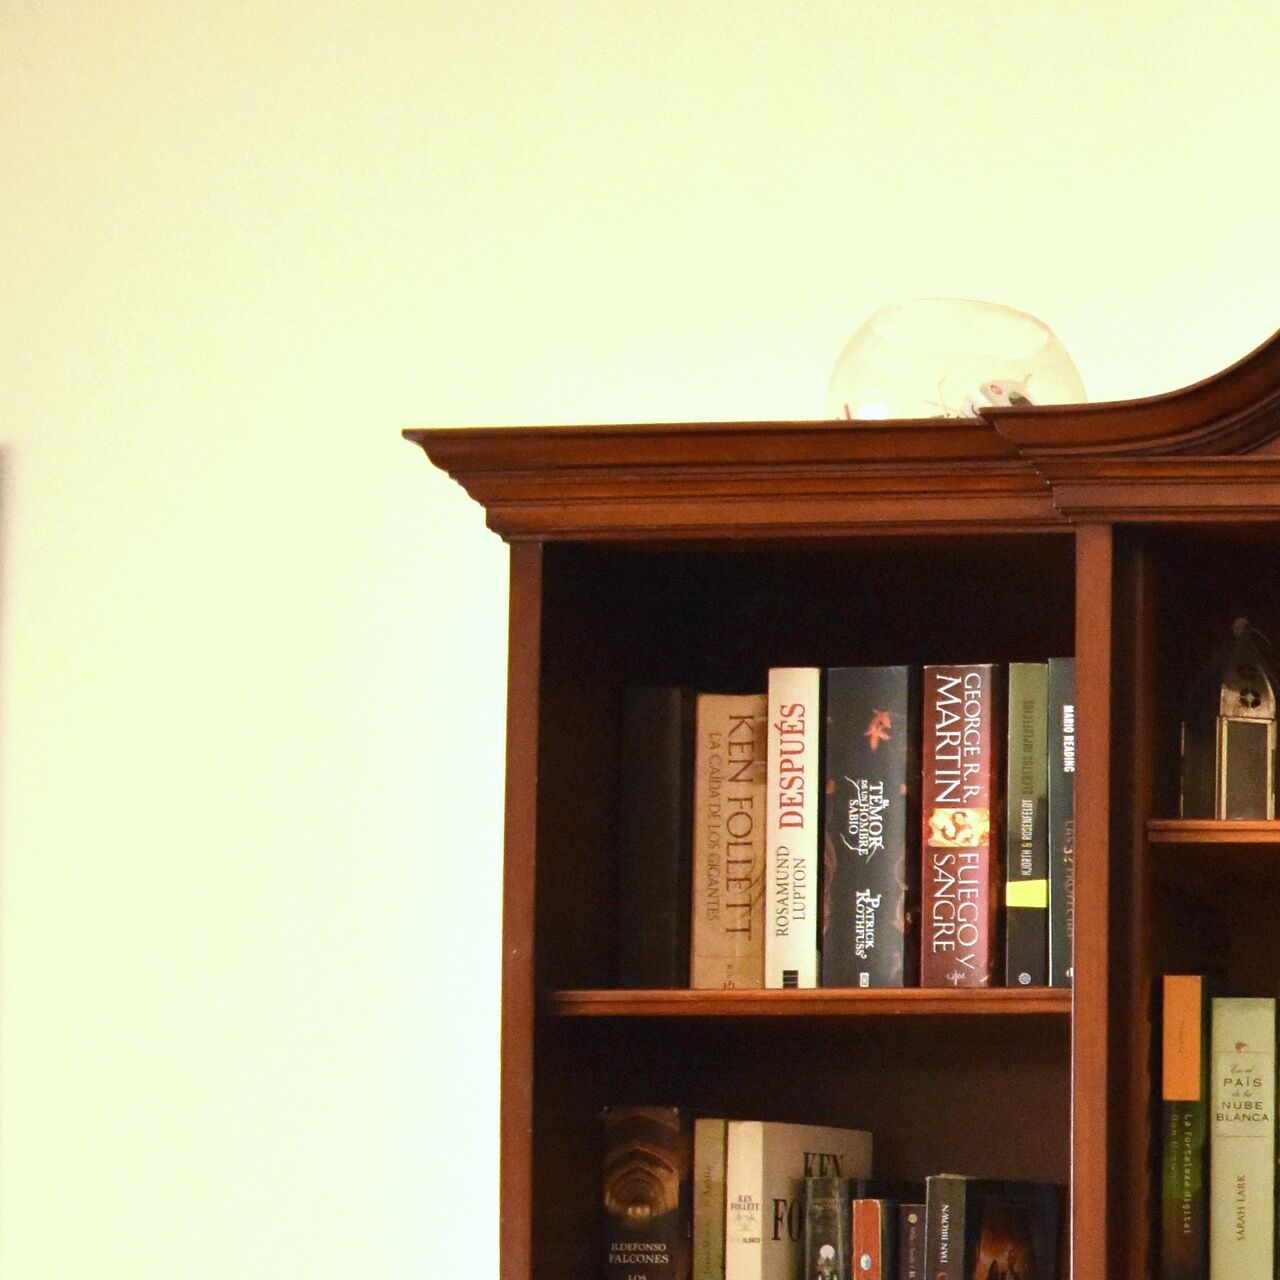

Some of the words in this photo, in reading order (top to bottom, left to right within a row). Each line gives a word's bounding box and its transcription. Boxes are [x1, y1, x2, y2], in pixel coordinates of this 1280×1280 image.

[963, 672, 982, 758] GEORGE
[1062, 705, 1074, 733] MARIO
[708, 733, 722, 750] LA
[727, 715, 755, 784] KEN
[934, 675, 962, 804] MARTIN
[1063, 735, 1075, 773] READING
[774, 703, 805, 829] DESPUÉS
[963, 762, 981, 782] R.
[707, 803, 721, 820] DE
[963, 785, 980, 804] R.
[849, 799, 859, 835] SABIO
[858, 800, 870, 856] HOMBRE
[867, 781, 884, 850] TEMOR
[707, 824, 720, 850] LOS
[706, 853, 720, 923] GIGANTES
[726, 797, 754, 941] FOLLETT
[776, 845, 790, 937] ROSAMUND
[793, 857, 806, 920] LUPTON
[933, 852, 956, 954] SANGRE
[956, 853, 980, 947] FUEGO
[855, 889, 871, 960] ROTHFUSS
[864, 894, 881, 949] PATRICK
[1223, 1076, 1263, 1087] PAÍS
[1215, 1113, 1270, 1122] BLANCA
[1222, 1101, 1264, 1110] NUBE
[1235, 1174, 1247, 1202] LARK
[940, 1204, 951, 1241] BROWN
[1181, 1191, 1193, 1233] digital
[1236, 1205, 1247, 1241] SARAH
[608, 1253, 670, 1264] FALCONES
[940, 1242, 949, 1263] DAN
